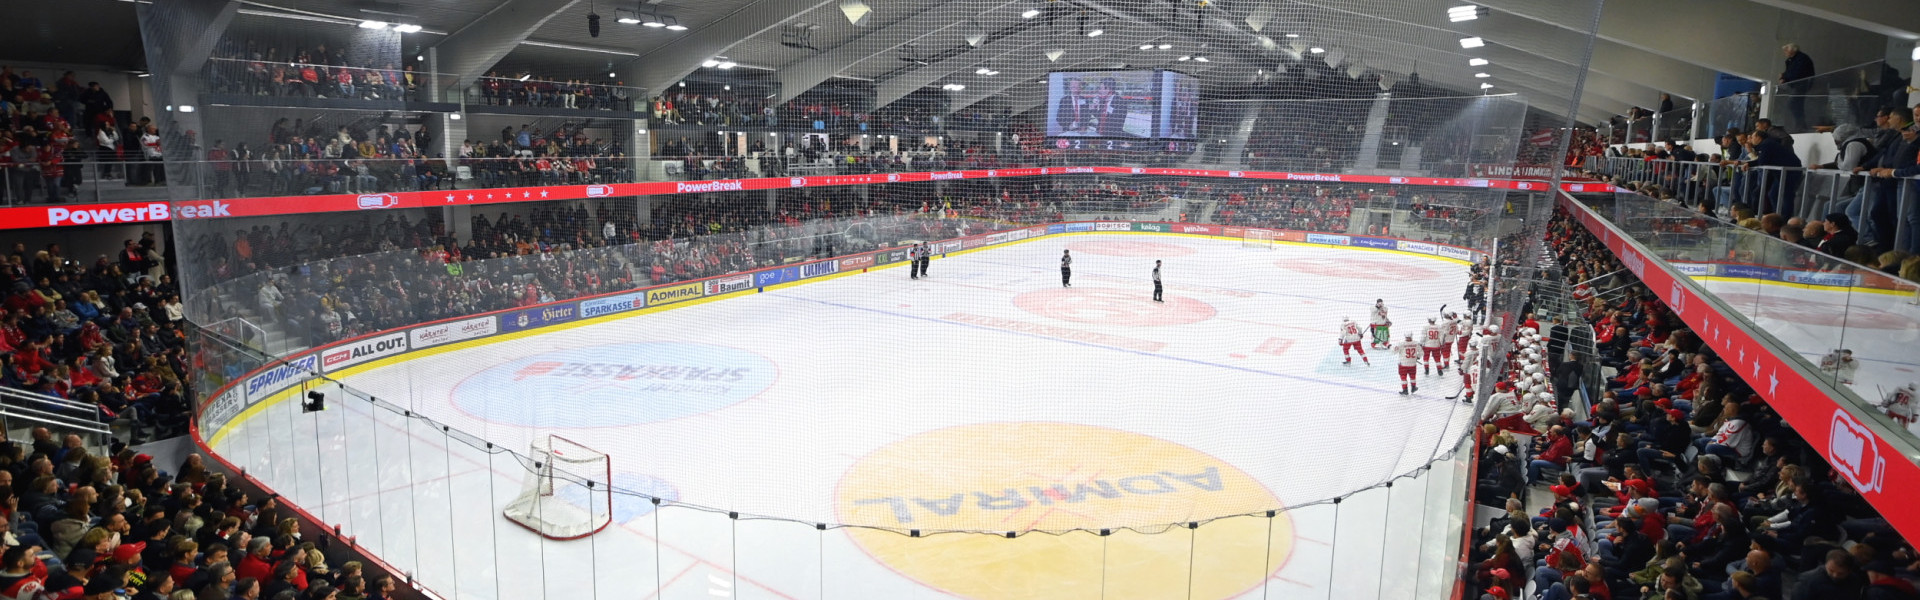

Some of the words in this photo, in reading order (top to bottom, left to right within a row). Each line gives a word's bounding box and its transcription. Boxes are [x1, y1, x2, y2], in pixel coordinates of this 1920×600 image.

[1074, 140, 1081, 149] 2
[1107, 140, 1113, 149] 2
[930, 171, 963, 180] PowerBreak
[1287, 173, 1341, 181] PowerBreak
[677, 180, 743, 192] PowerBreak
[48, 200, 231, 226] PowerBreak
[720, 279, 750, 292] Baumit
[650, 286, 701, 303] ADMIRAL
[542, 307, 573, 321] Hirter
[585, 301, 632, 316] SPARKASSE
[1428, 331, 1439, 340] 90
[326, 352, 348, 364] CCM
[352, 344, 375, 359] ALL
[376, 337, 405, 352] OUT.
[1405, 348, 1416, 359] 92
[248, 356, 315, 396] SPRINGER
[553, 362, 750, 383] SPARKASSE
[854, 467, 1224, 523] ADMIRAL
